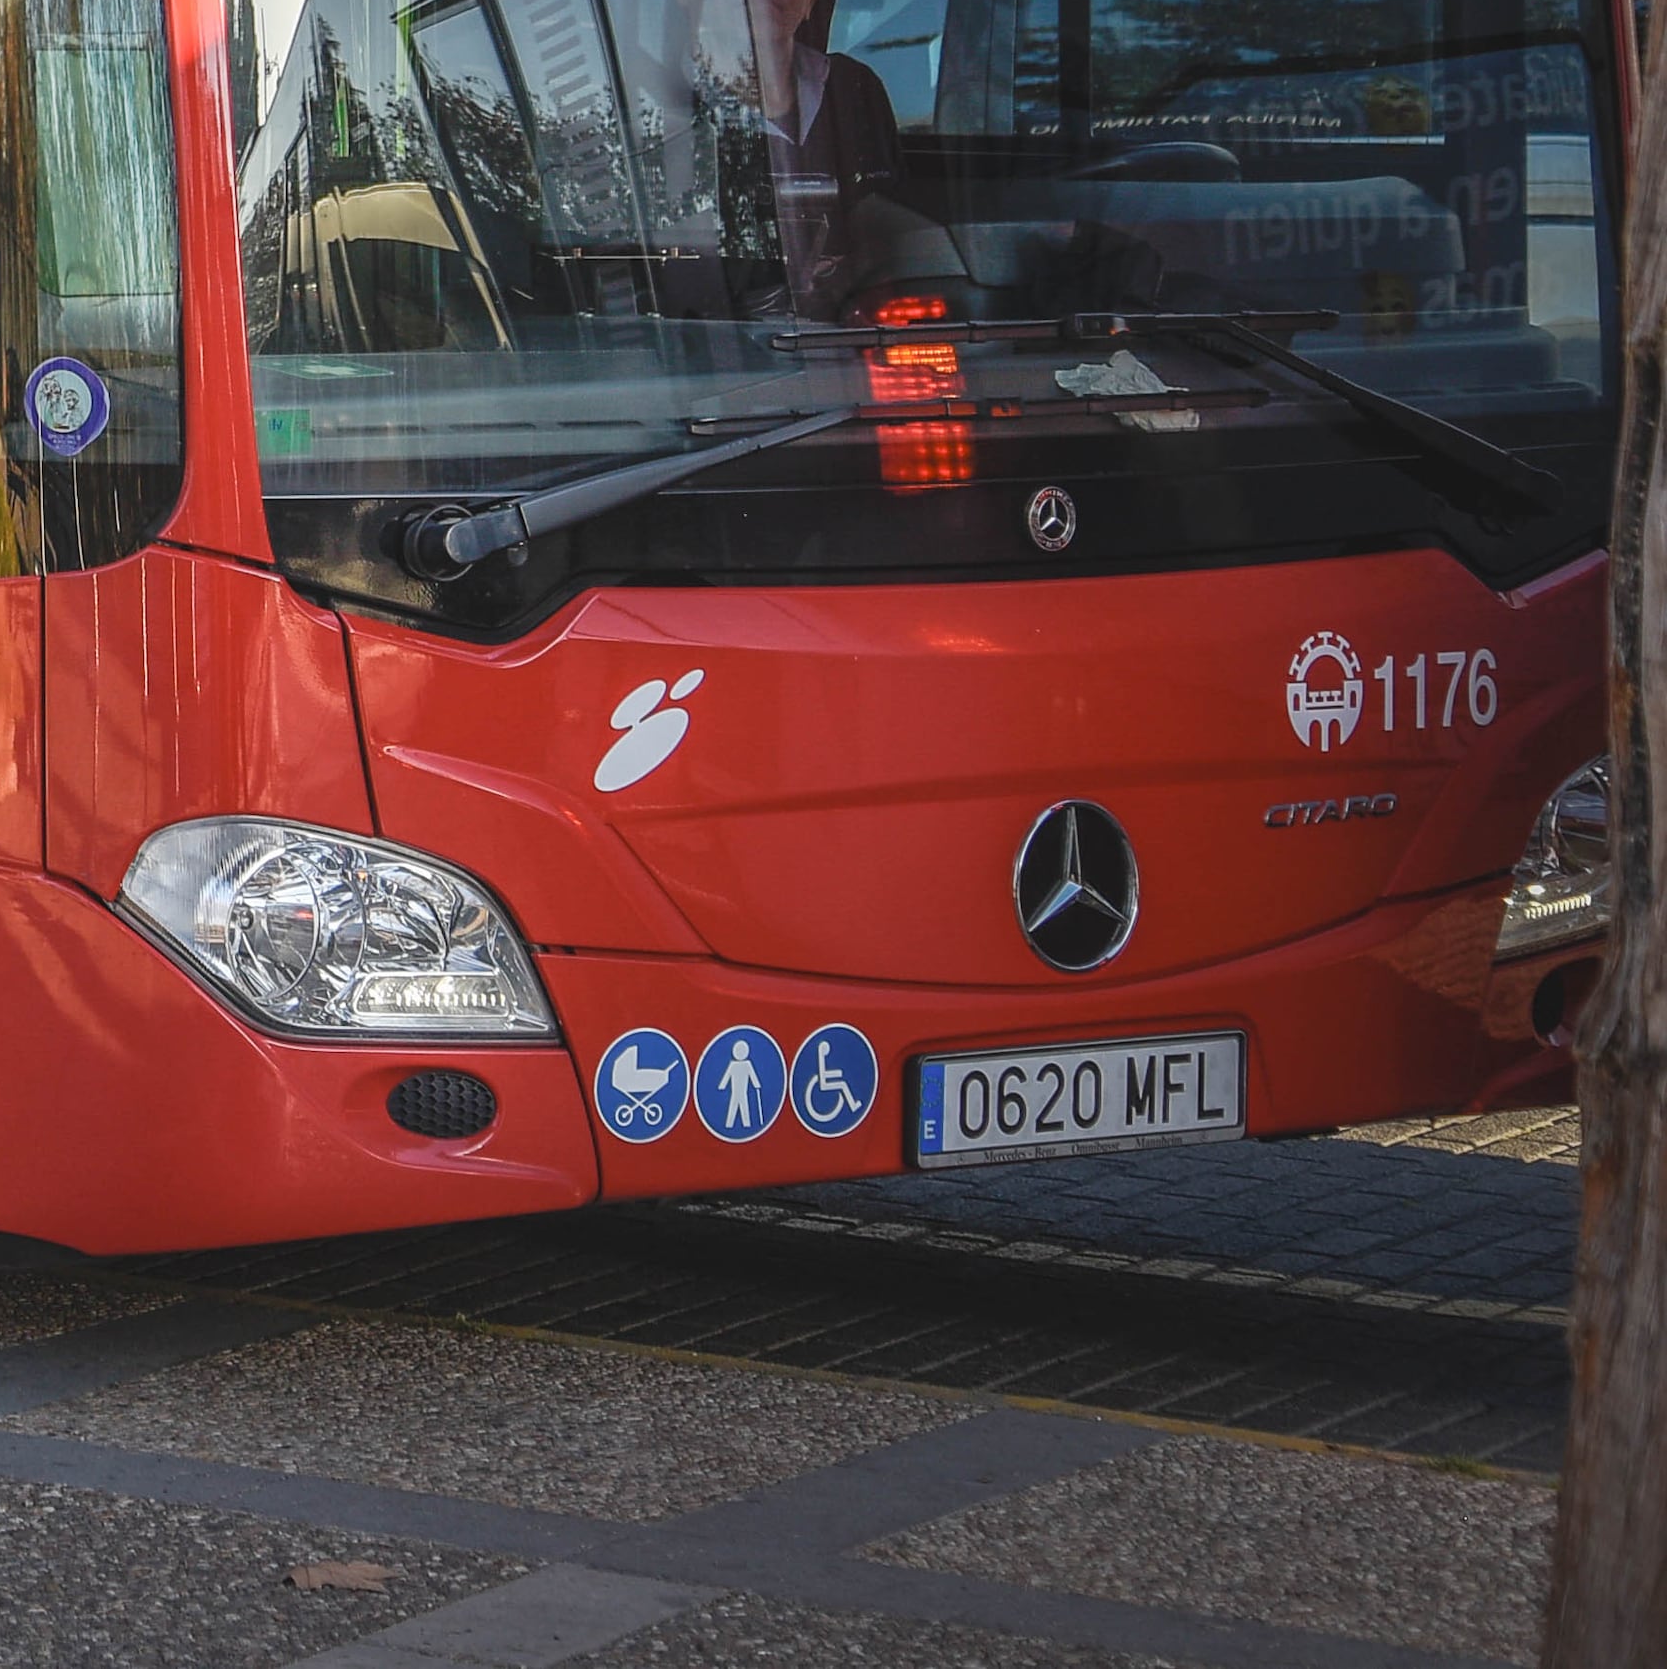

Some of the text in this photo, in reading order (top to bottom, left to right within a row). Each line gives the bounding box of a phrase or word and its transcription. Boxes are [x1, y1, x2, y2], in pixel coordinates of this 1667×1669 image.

[1373, 647, 1499, 732] 1176
[1263, 792, 1400, 828] CITARO
[958, 1051, 1226, 1140] 0620 MFL
[922, 1119, 937, 1140] E
